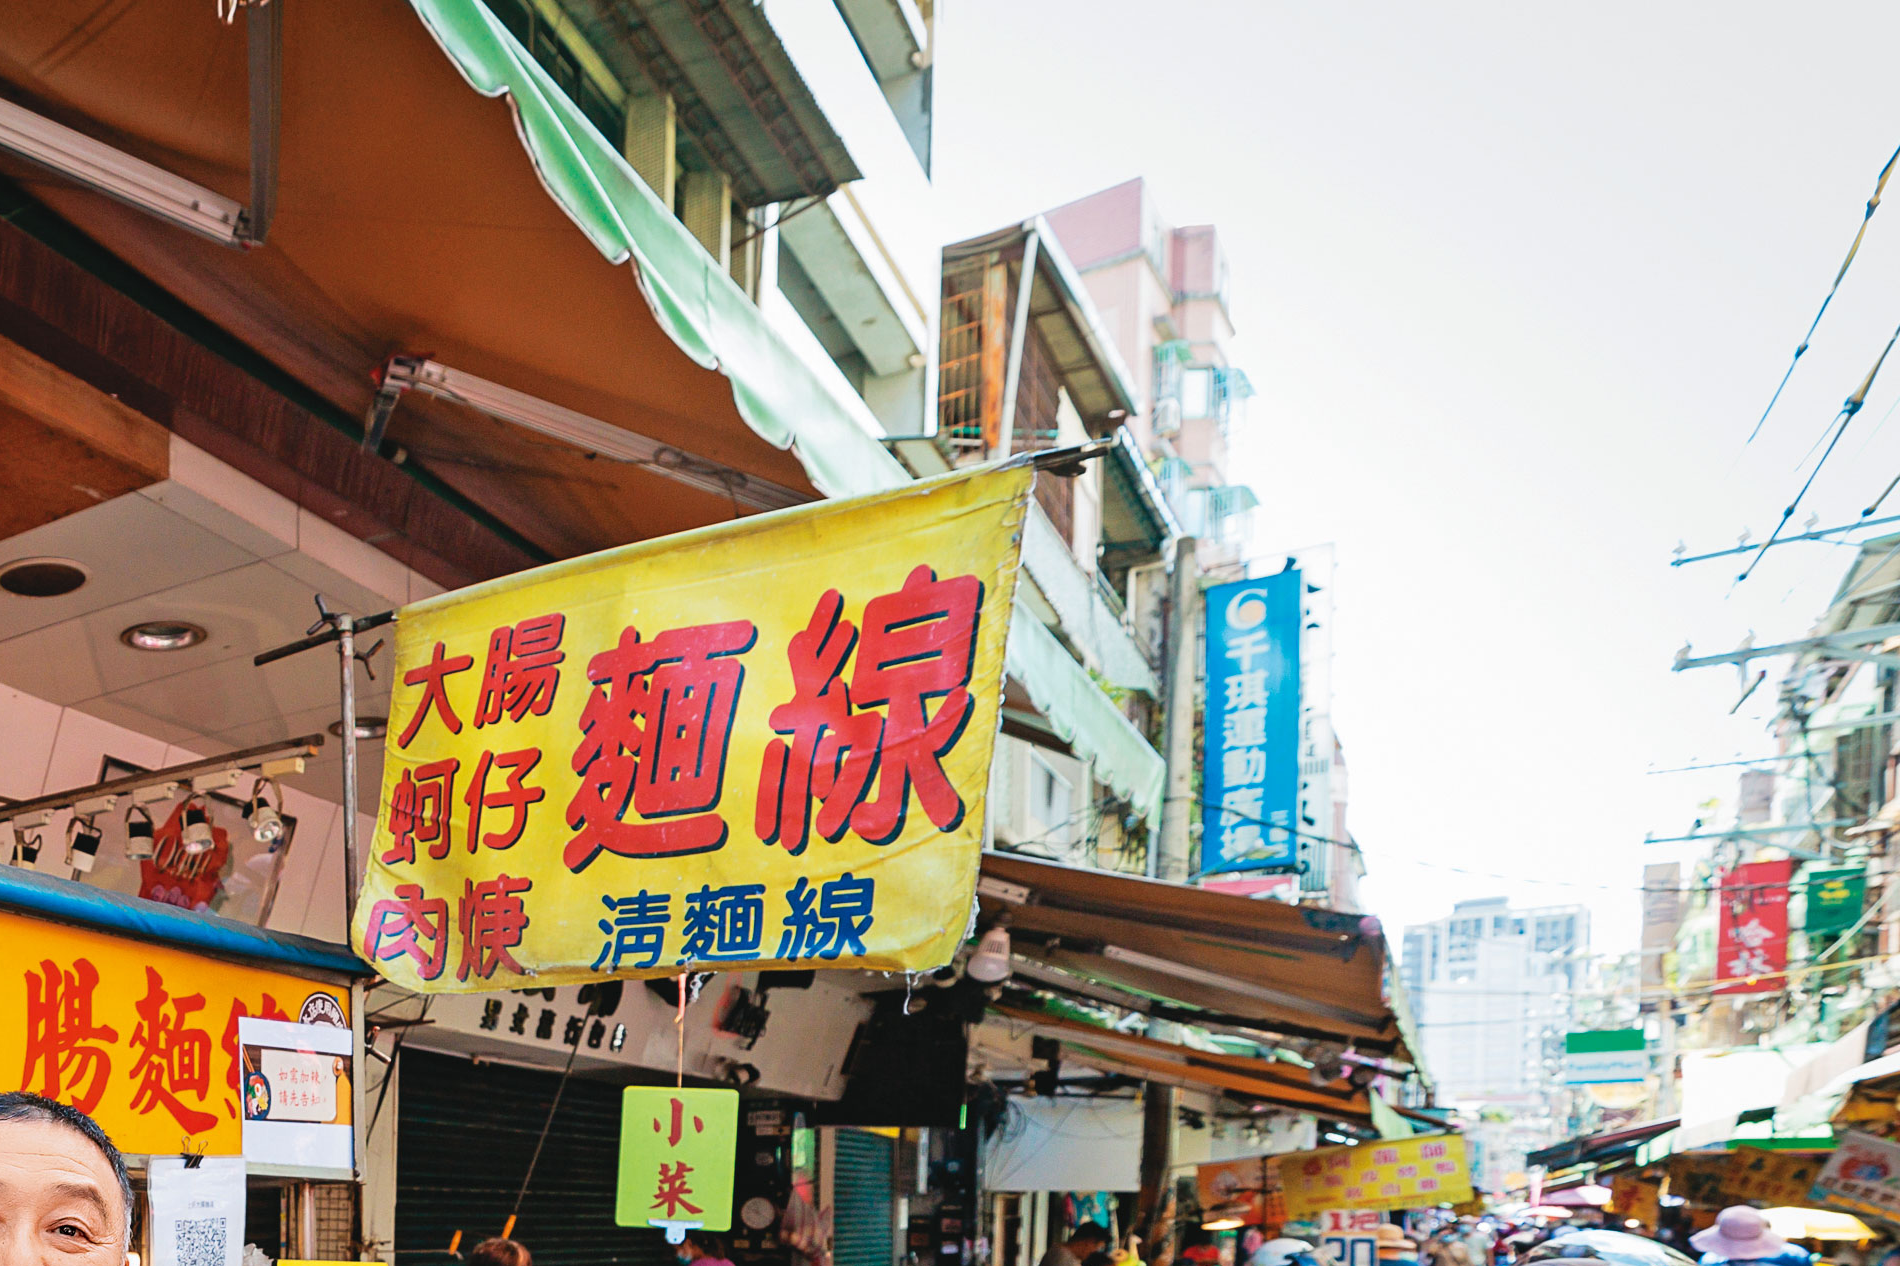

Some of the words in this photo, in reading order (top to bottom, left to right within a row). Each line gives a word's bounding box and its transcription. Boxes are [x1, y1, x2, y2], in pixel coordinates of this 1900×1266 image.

[398, 612, 567, 750] 大腸
[562, 563, 986, 874] 麵線
[381, 748, 544, 865] 蚵仔
[589, 872, 876, 971] 清麵線
[649, 1096, 704, 1218] 小菜
